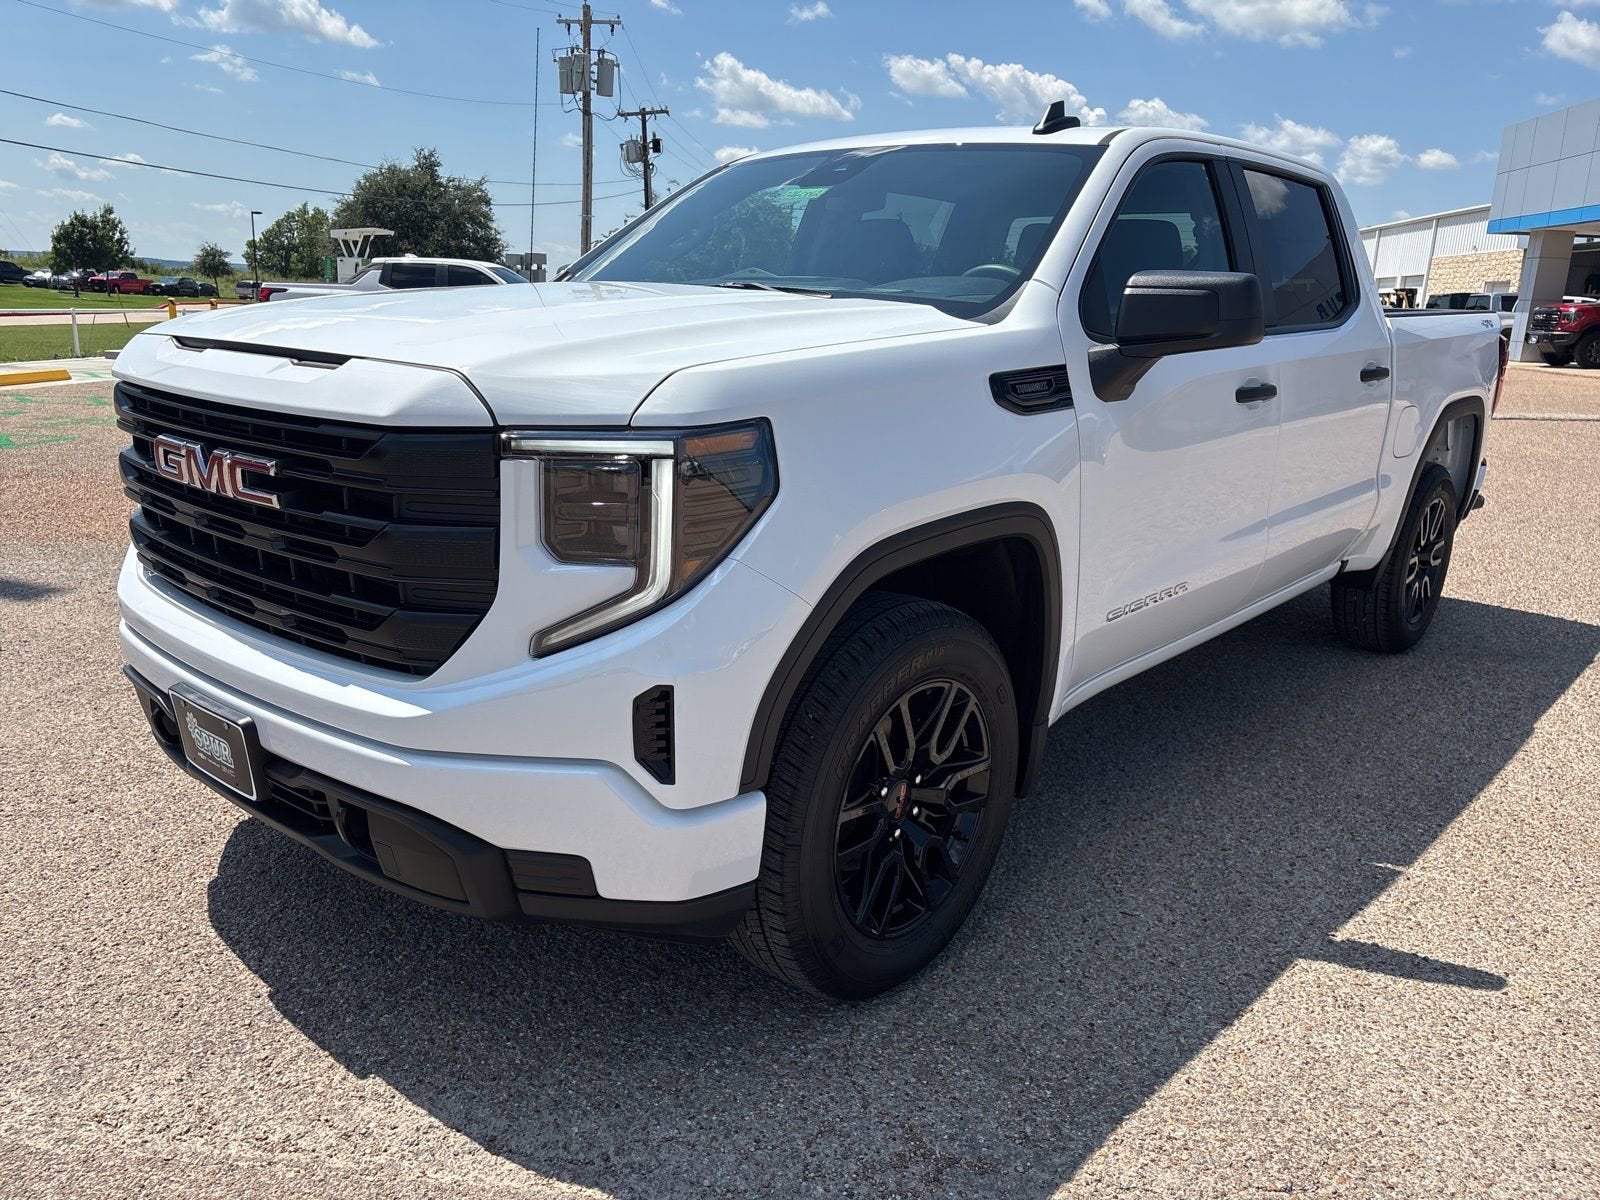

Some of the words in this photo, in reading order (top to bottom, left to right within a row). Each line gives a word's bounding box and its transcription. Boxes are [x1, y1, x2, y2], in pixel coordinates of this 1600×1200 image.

[154, 433, 280, 509] GMC
[1105, 581, 1188, 622] SIERRA
[194, 727, 233, 764] SPUR
